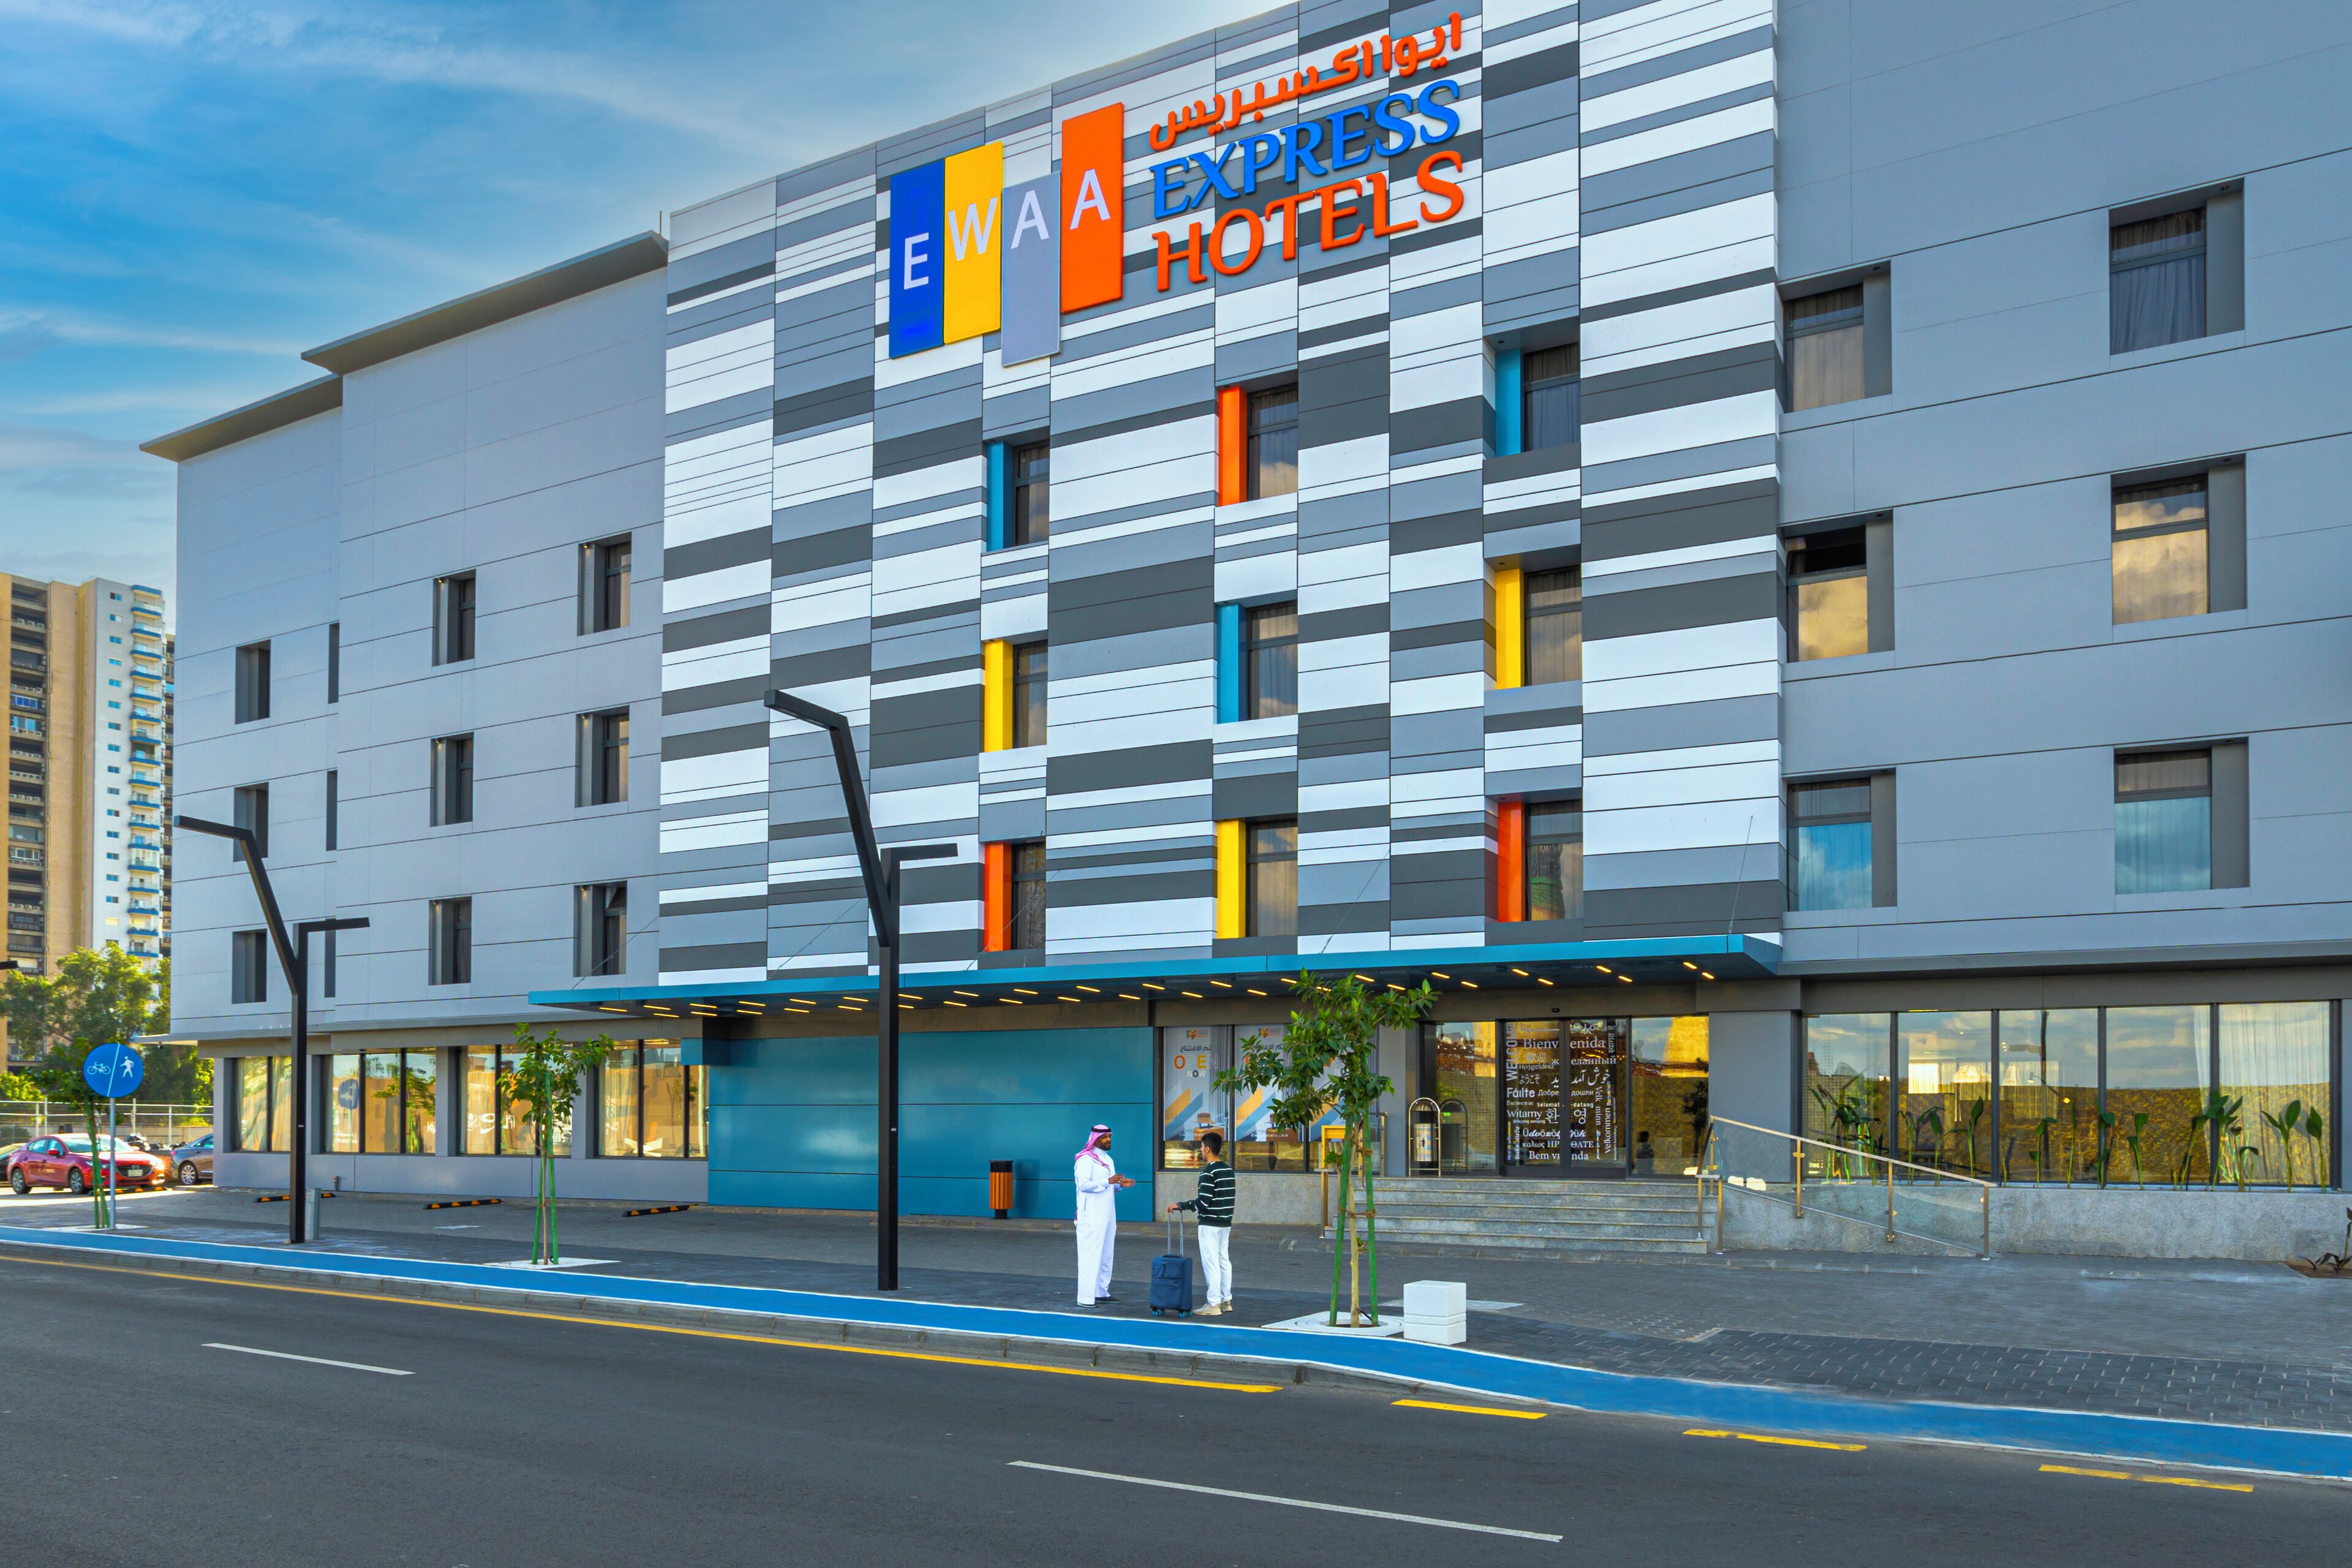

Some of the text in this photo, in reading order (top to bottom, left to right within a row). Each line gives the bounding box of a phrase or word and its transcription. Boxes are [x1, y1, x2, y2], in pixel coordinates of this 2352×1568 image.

[1149, 80, 1460, 221] EXPRESS
[903, 168, 1110, 290] EWAA
[1152, 151, 1464, 292] HOTELS
[1174, 1054, 1218, 1070] OPEN
[1506, 1022, 1517, 1081] WELCOME
[1519, 1074, 1540, 1085] ようこそ
[1506, 1109, 1542, 1120] Witamy
[1529, 1150, 1549, 1159] Bem
